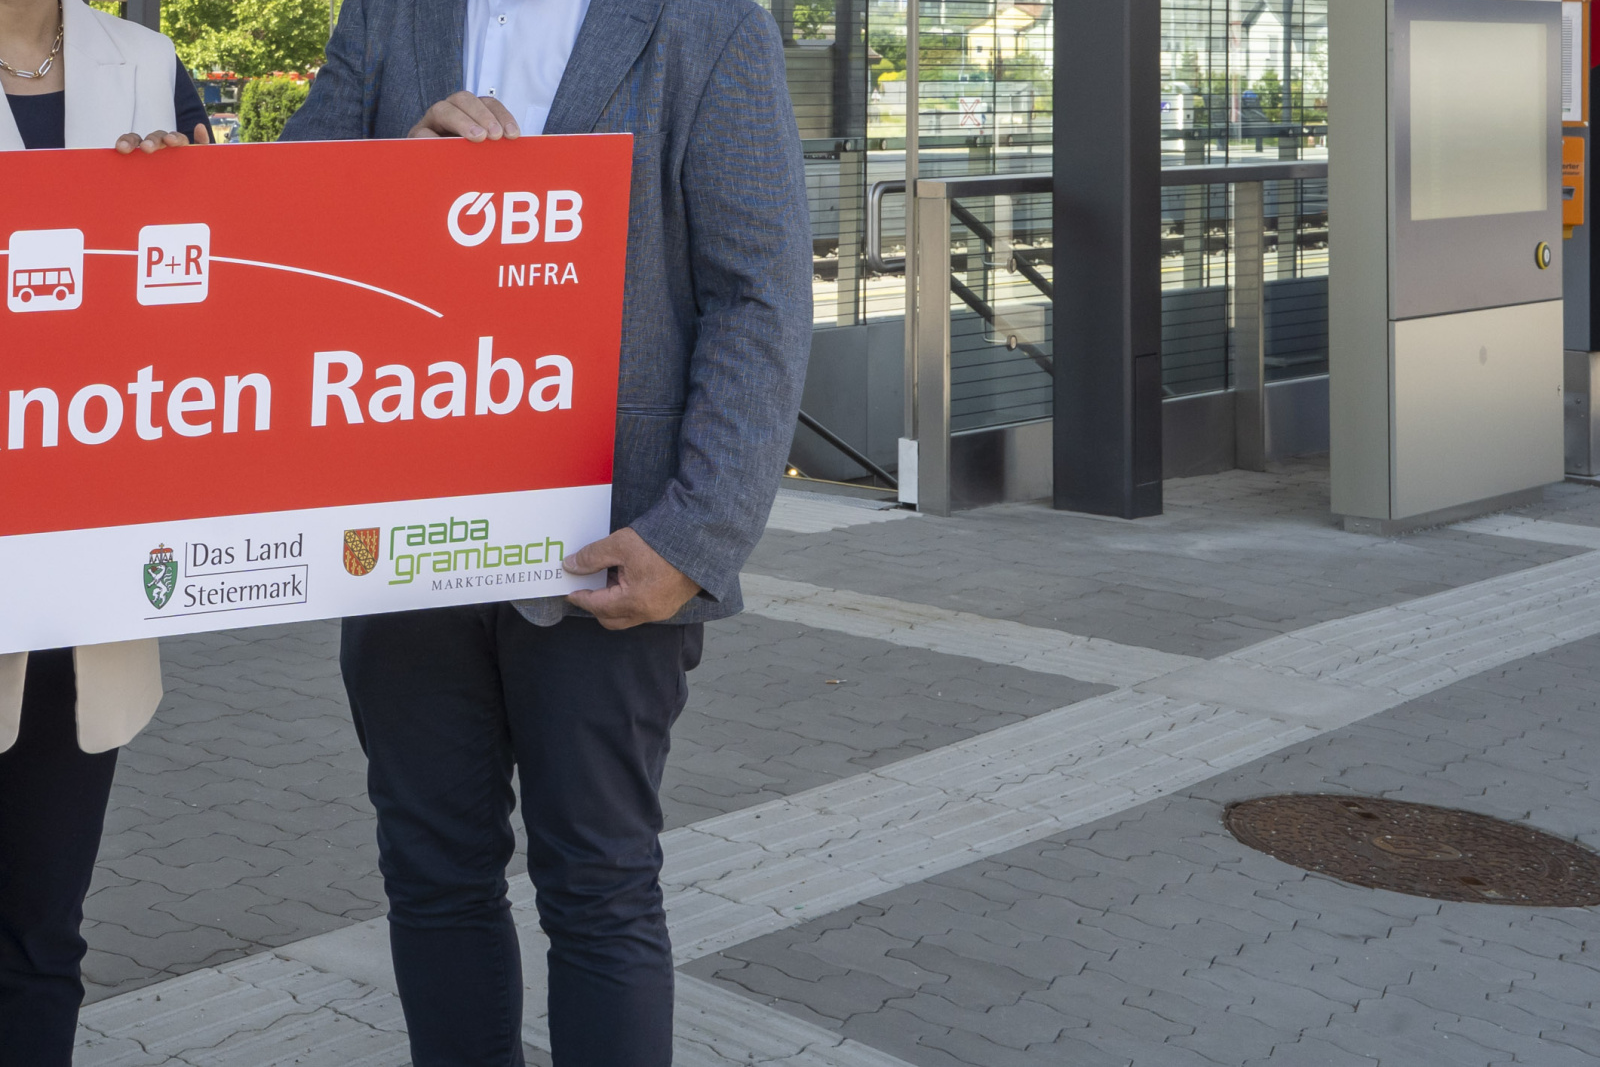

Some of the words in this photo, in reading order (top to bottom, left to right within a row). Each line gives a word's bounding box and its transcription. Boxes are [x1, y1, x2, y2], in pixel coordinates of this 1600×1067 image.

[447, 190, 583, 247] ÖBB
[145, 244, 204, 278] P+R
[498, 262, 579, 287] INFRA
[311, 336, 574, 427] Raaba
[191, 543, 235, 567] Das
[245, 533, 303, 562] Land
[390, 517, 489, 560] raaba
[388, 536, 564, 585] grambach
[184, 574, 303, 607] Steiermark
[431, 568, 563, 591] MARKTGEMEINDE
